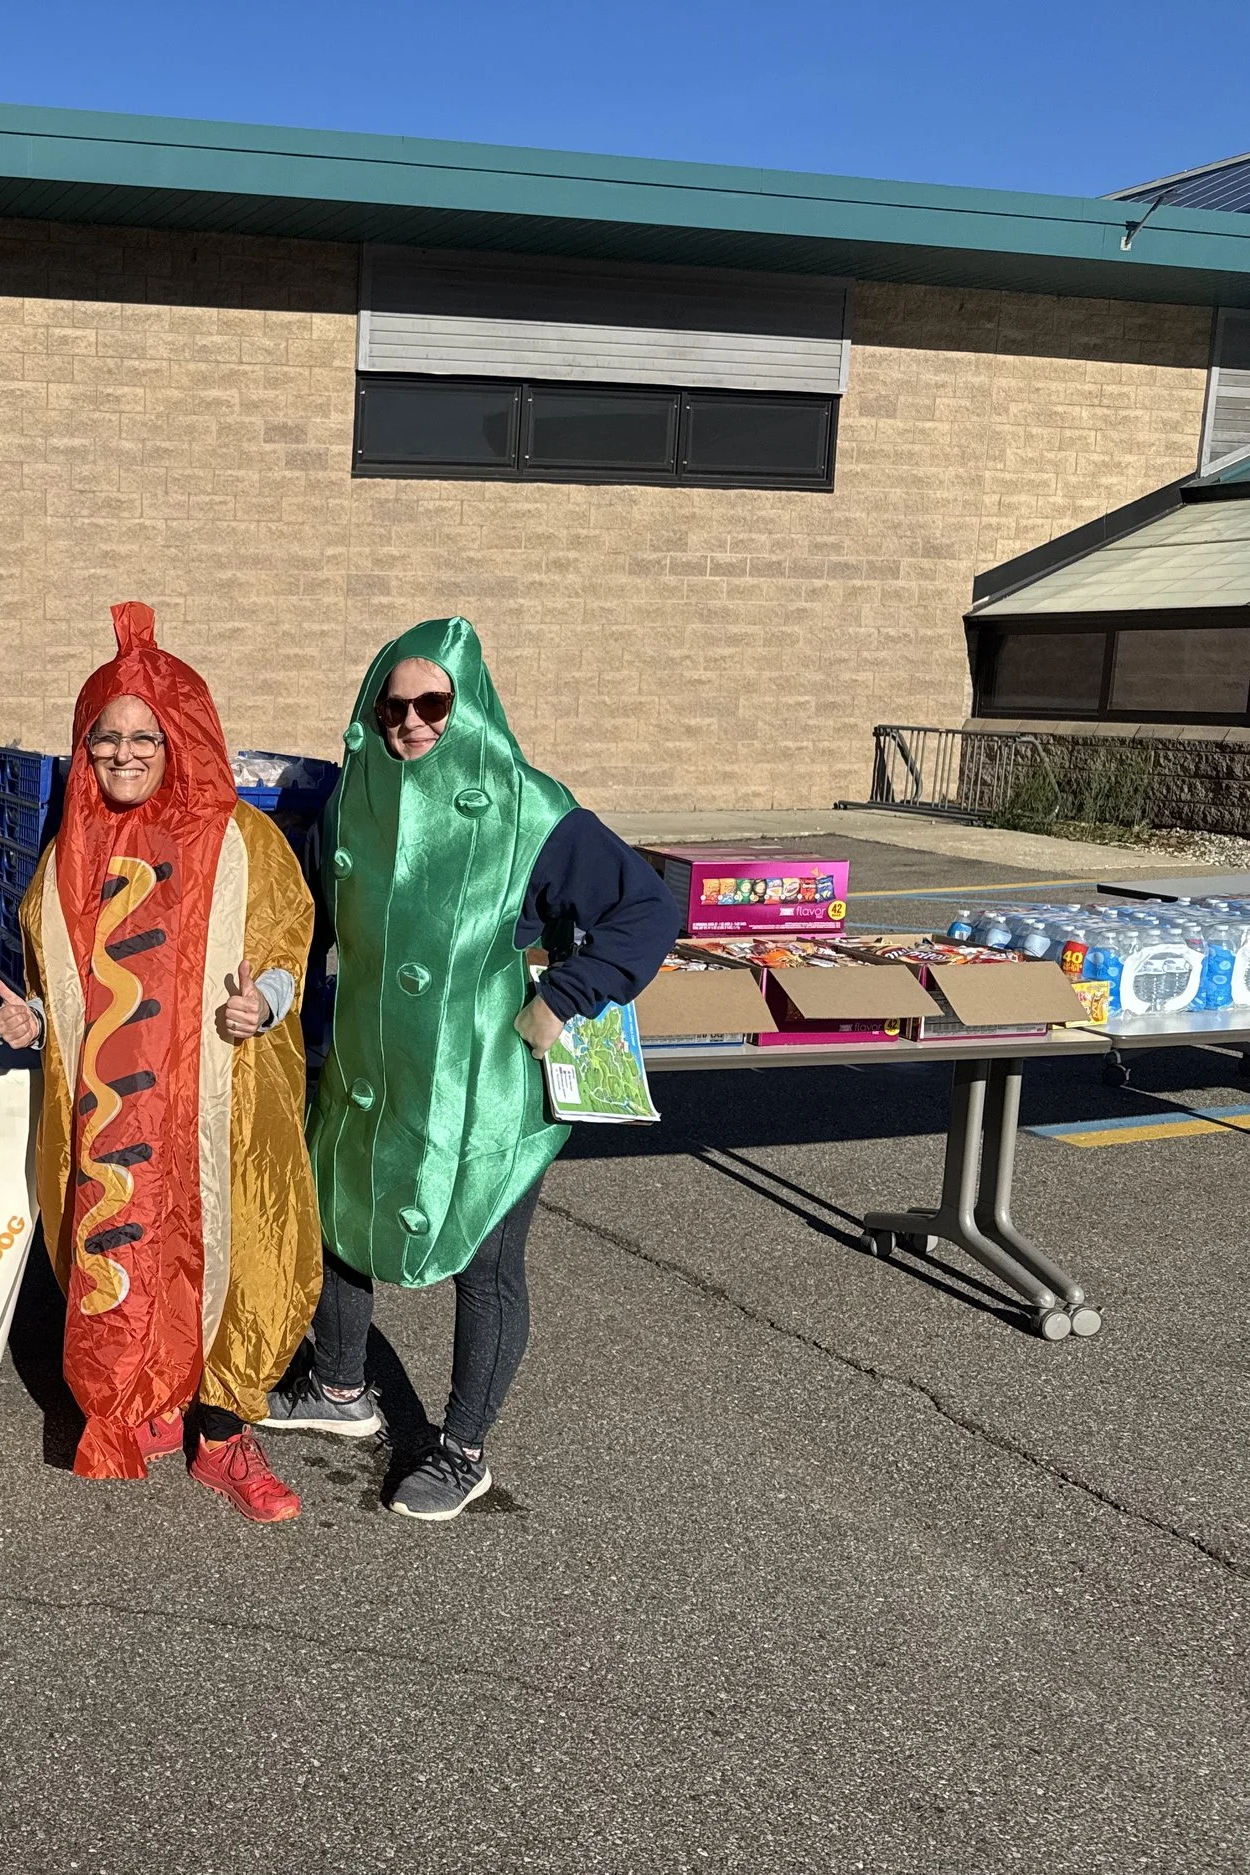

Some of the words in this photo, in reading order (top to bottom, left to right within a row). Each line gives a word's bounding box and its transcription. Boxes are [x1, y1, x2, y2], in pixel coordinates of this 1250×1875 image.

[796, 905, 827, 917] flavor
[831, 903, 843, 914] 42
[1063, 950, 1083, 964] 40
